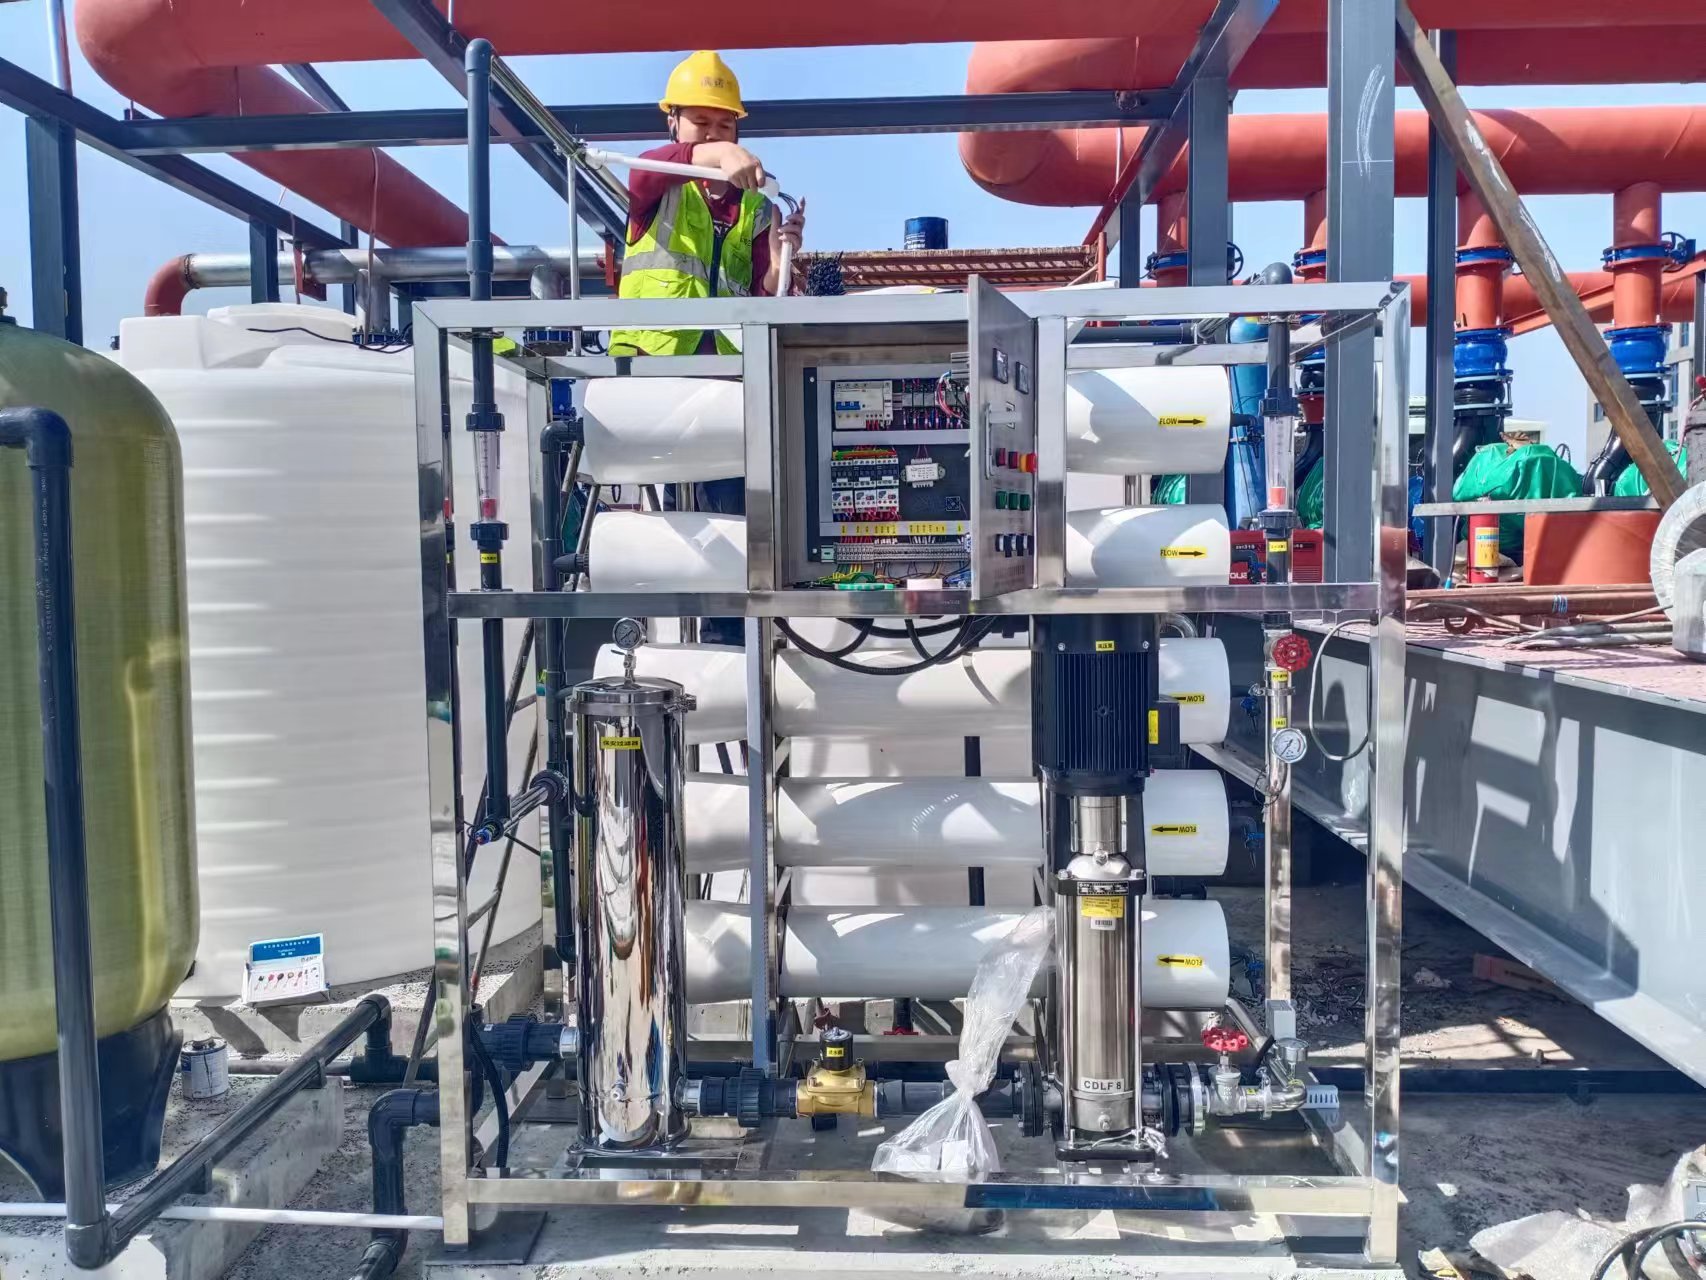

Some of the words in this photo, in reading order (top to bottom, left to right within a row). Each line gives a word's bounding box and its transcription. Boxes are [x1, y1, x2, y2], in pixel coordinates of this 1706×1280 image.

[1159, 417, 1178, 426] FLOW
[1160, 549, 1179, 557] FLOW
[1186, 695, 1205, 703] FLOW
[1177, 825, 1197, 833] FLOW
[1184, 958, 1203, 966] FLOW
[1083, 1080, 1114, 1091] CDLF
[1116, 1081, 1122, 1090] 8
